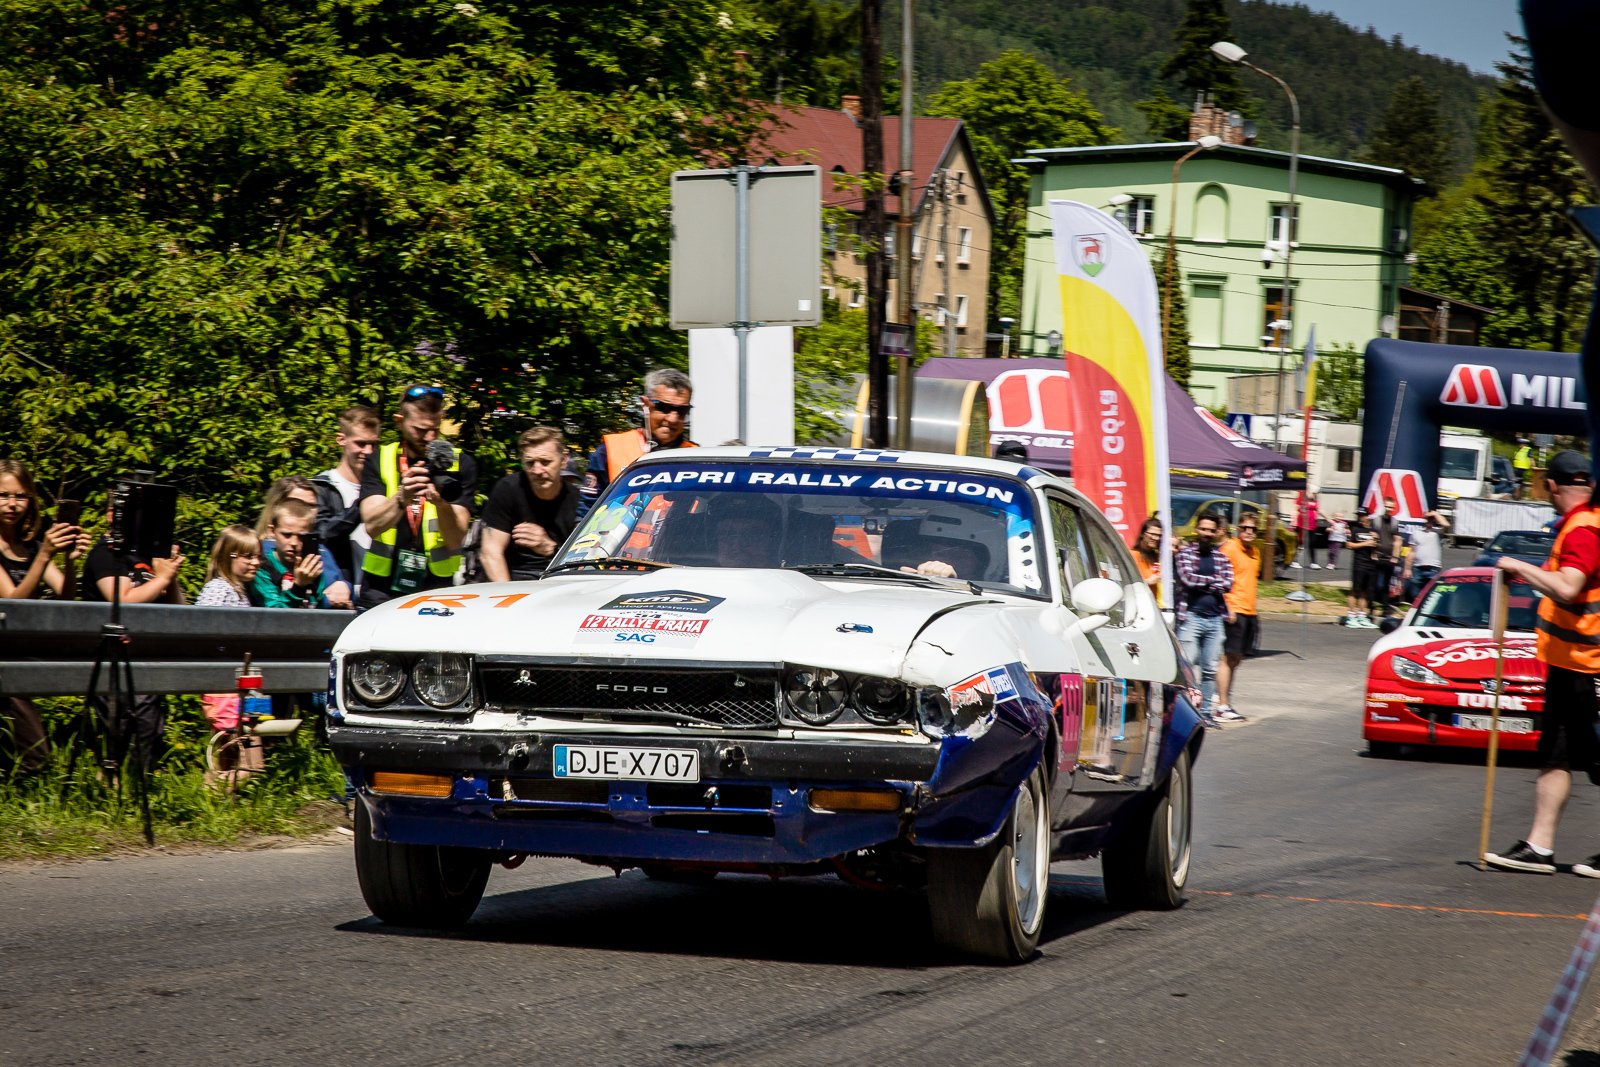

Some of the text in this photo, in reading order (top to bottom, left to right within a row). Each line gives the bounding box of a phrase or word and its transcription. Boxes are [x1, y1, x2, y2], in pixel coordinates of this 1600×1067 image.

[627, 471, 1014, 503] CAPRI RALLY ACTION
[397, 594, 530, 609] R1
[655, 619, 704, 633] PRAHA
[615, 633, 656, 643] SAG
[596, 684, 668, 694] FORD
[569, 750, 695, 777] DJE X707
